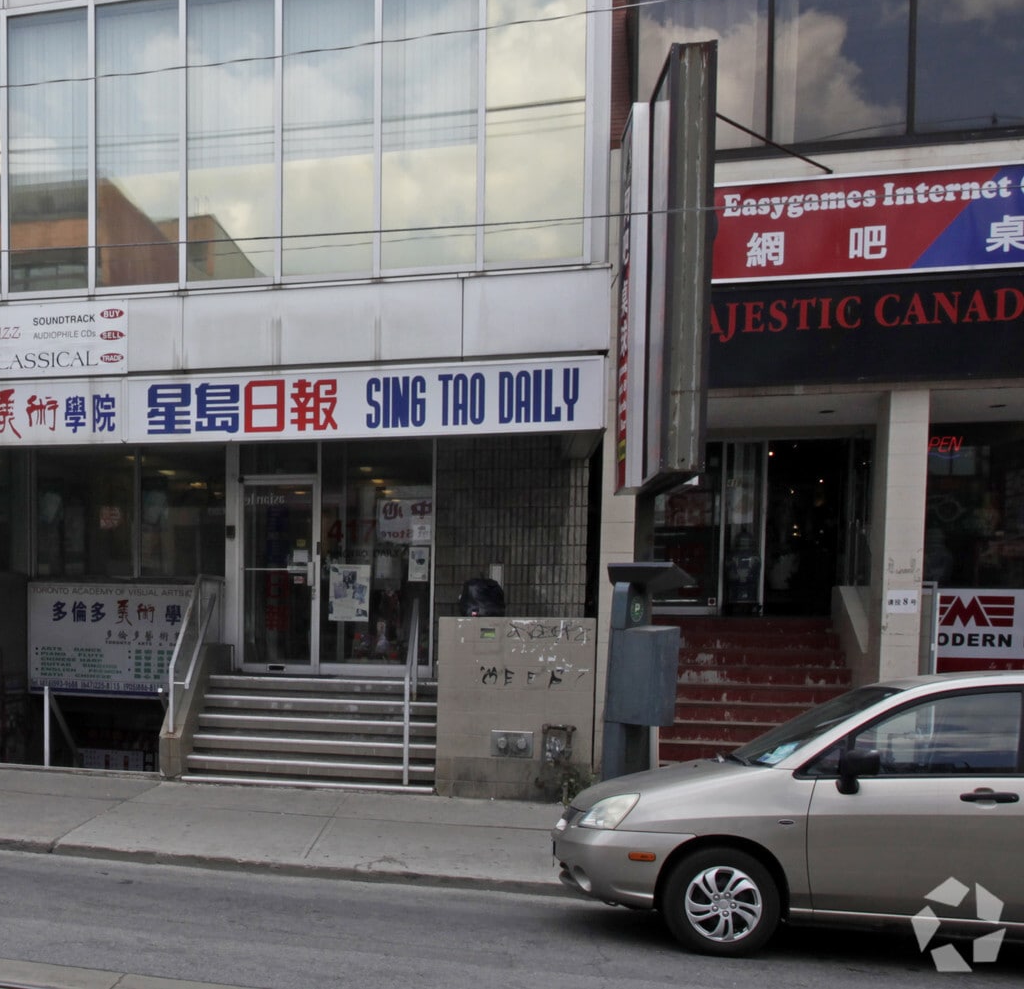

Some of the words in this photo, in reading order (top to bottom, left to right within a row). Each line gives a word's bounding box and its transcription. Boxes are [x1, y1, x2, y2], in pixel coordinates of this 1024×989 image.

[723, 189, 876, 219] Easygames
[883, 176, 1012, 207] Internet
[746, 225, 888, 268] 網吧
[32, 314, 96, 327] SOUNDTRACK
[102, 309, 122, 318] BUY
[710, 296, 862, 343] AJESTIC
[33, 330, 78, 341] AUDIOPHILE
[80, 329, 97, 339] CDs
[102, 331, 123, 340] SELL
[101, 354, 123, 362] TRADE
[147, 378, 338, 435] 星島日報
[365, 374, 427, 429] SING
[438, 371, 486, 427] TAO
[498, 367, 580, 425] DAILY
[929, 435, 963, 452] PEN
[328, 519, 376, 542] 417
[32, 587, 69, 595] TORONTO
[72, 588, 113, 596] ACADEMY
[128, 589, 159, 597] VISUAL
[938, 632, 1012, 648] ODERN
